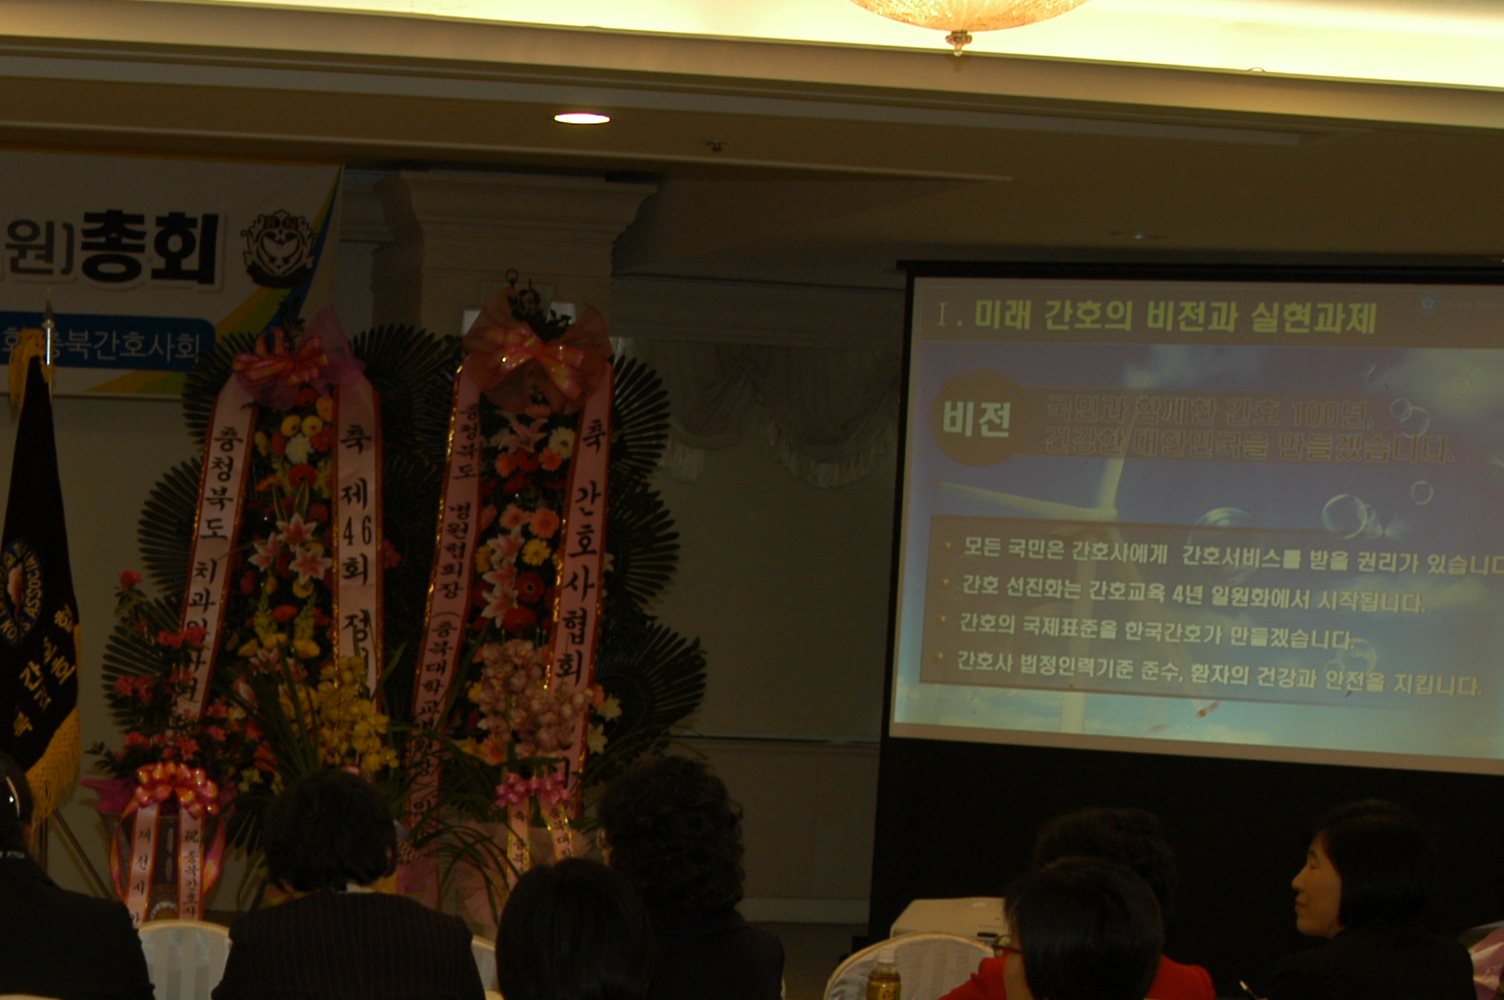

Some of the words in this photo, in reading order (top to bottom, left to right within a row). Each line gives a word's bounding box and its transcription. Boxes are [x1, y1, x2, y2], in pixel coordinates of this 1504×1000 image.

[975, 299, 1031, 330] 미래
[1045, 300, 1134, 332] 간호의
[1147, 301, 1239, 333] 비전과
[1250, 302, 1378, 335] 실현과제
[942, 400, 1012, 439] 비전
[1225, 398, 1281, 428] 간호
[340, 424, 373, 455] 축
[1133, 428, 1270, 461] 대한민국을
[199, 425, 245, 541] 충청북도
[340, 476, 373, 586] 제46회
[964, 535, 1002, 558] 모든
[1008, 537, 1066, 562] 국민은
[1072, 540, 1169, 566] 간호사에게
[1182, 544, 1302, 571] 간호서비스를
[1357, 550, 1421, 575] 권리가
[962, 573, 1000, 596] 간호
[1006, 575, 1083, 600] 선진화는
[1089, 579, 1166, 604] 간호교육
[1171, 583, 1204, 606] 4년
[1211, 585, 1312, 611] 일원화에서
[959, 611, 1016, 635] 간호의
[1022, 615, 1118, 640] 국제표준을
[1125, 620, 1223, 645] 한국간호가
[957, 650, 1014, 673] 간호사
[1020, 654, 1134, 680] 법정인력기준
[1191, 662, 1250, 687] 환자의
[1257, 665, 1318, 690] 건강과
[1325, 669, 1386, 694] 안전을
